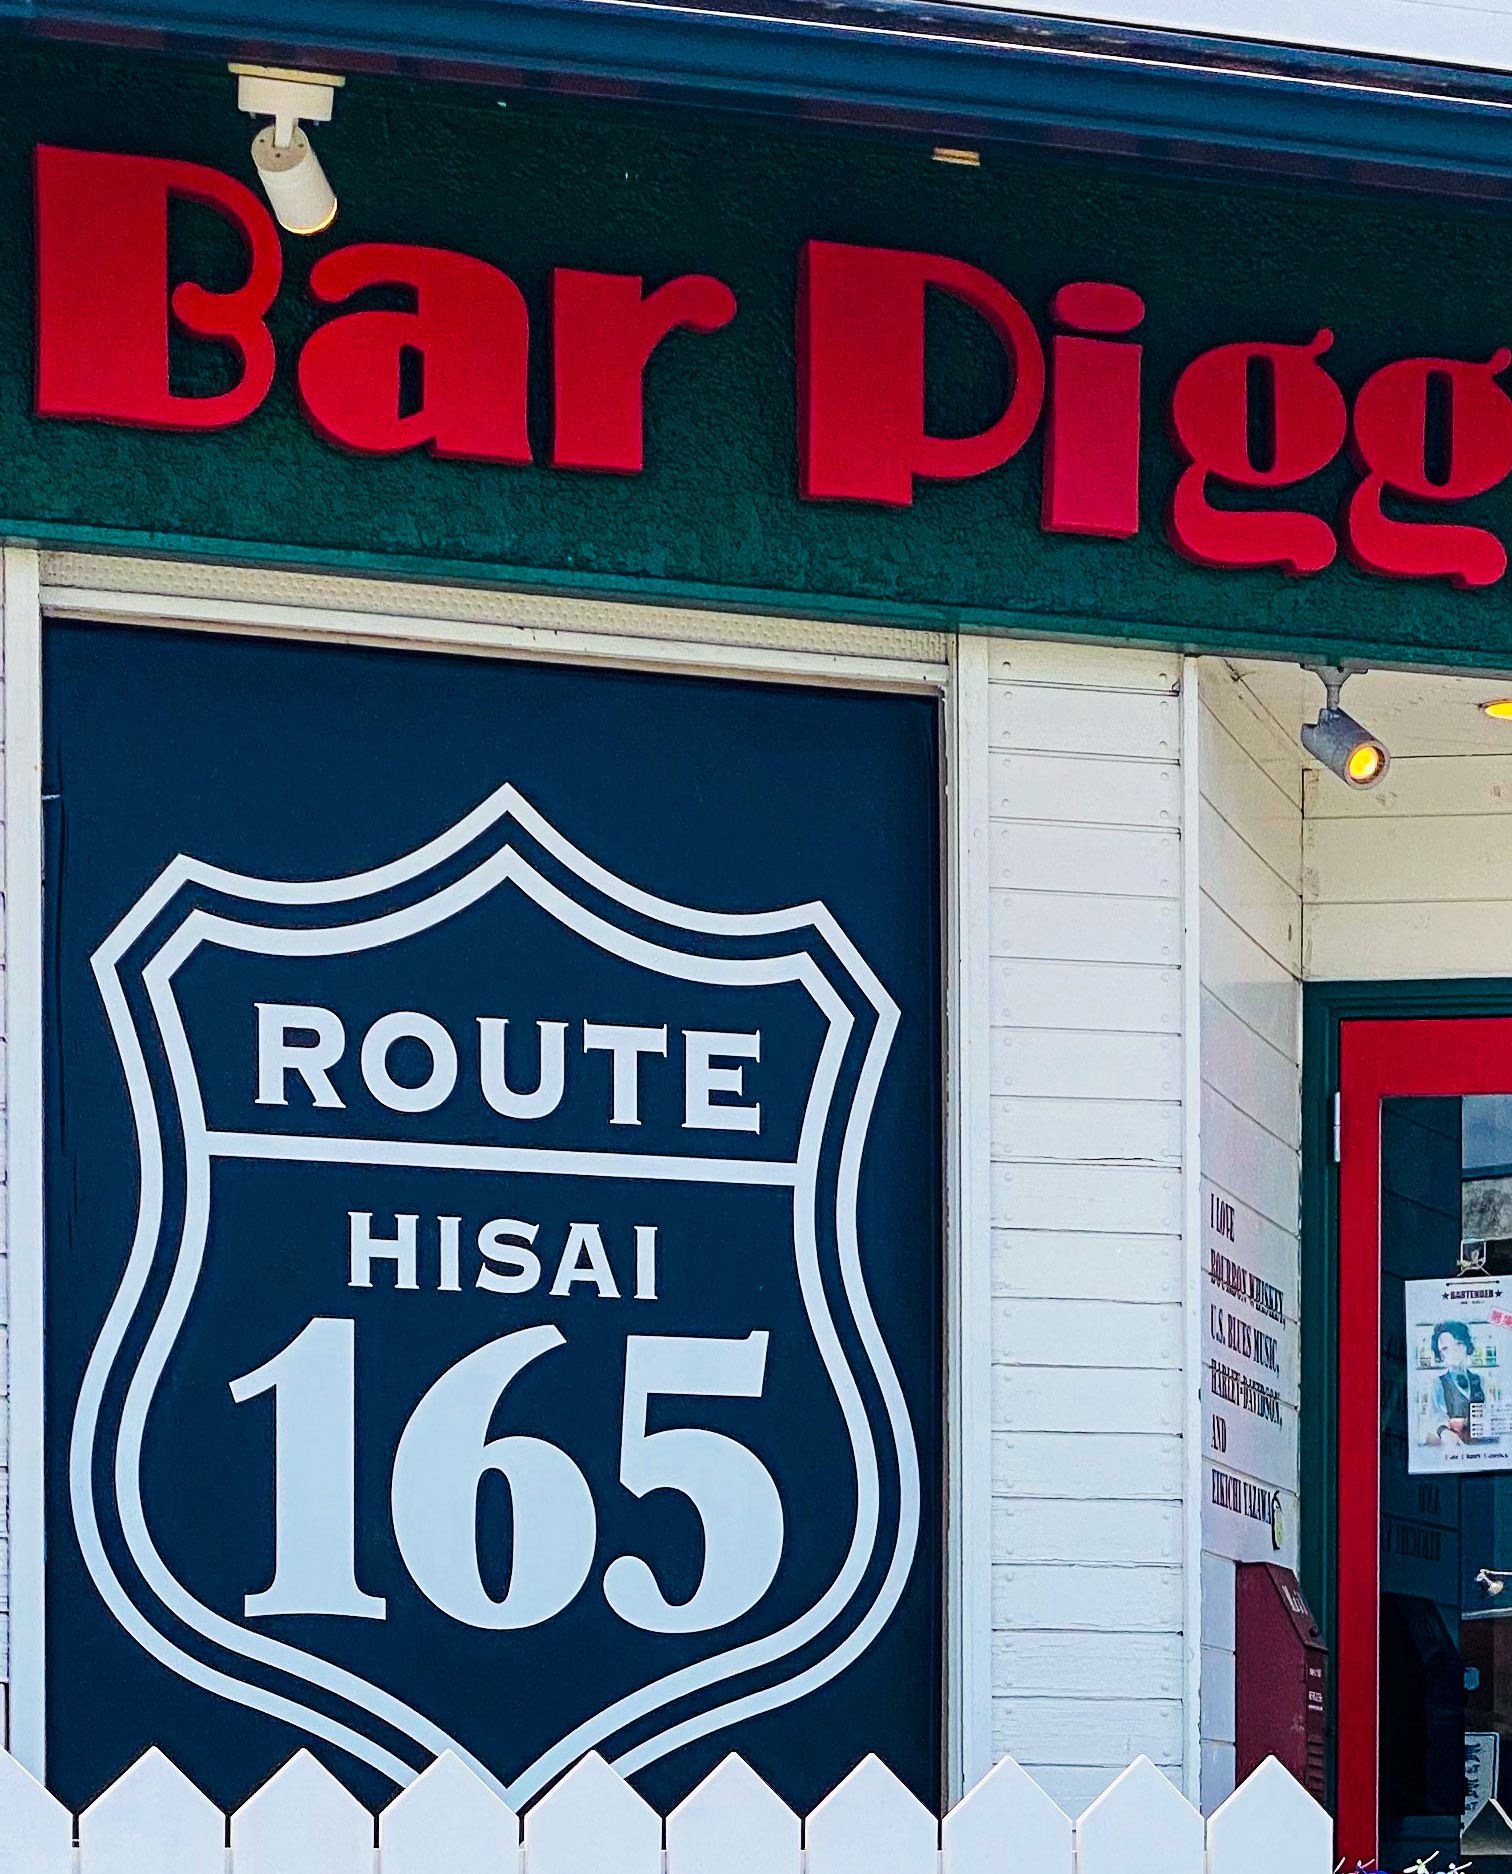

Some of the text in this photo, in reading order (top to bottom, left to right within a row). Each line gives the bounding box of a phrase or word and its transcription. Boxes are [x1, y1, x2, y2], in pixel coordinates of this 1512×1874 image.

[34, 143, 738, 475] Bar
[254, 1002, 762, 1135] ROUTE
[348, 1212, 659, 1299] HISAI
[1216, 1197, 1235, 1242] LOVE
[229, 1317, 784, 1633] 165
[1210, 1413, 1227, 1453] AND
